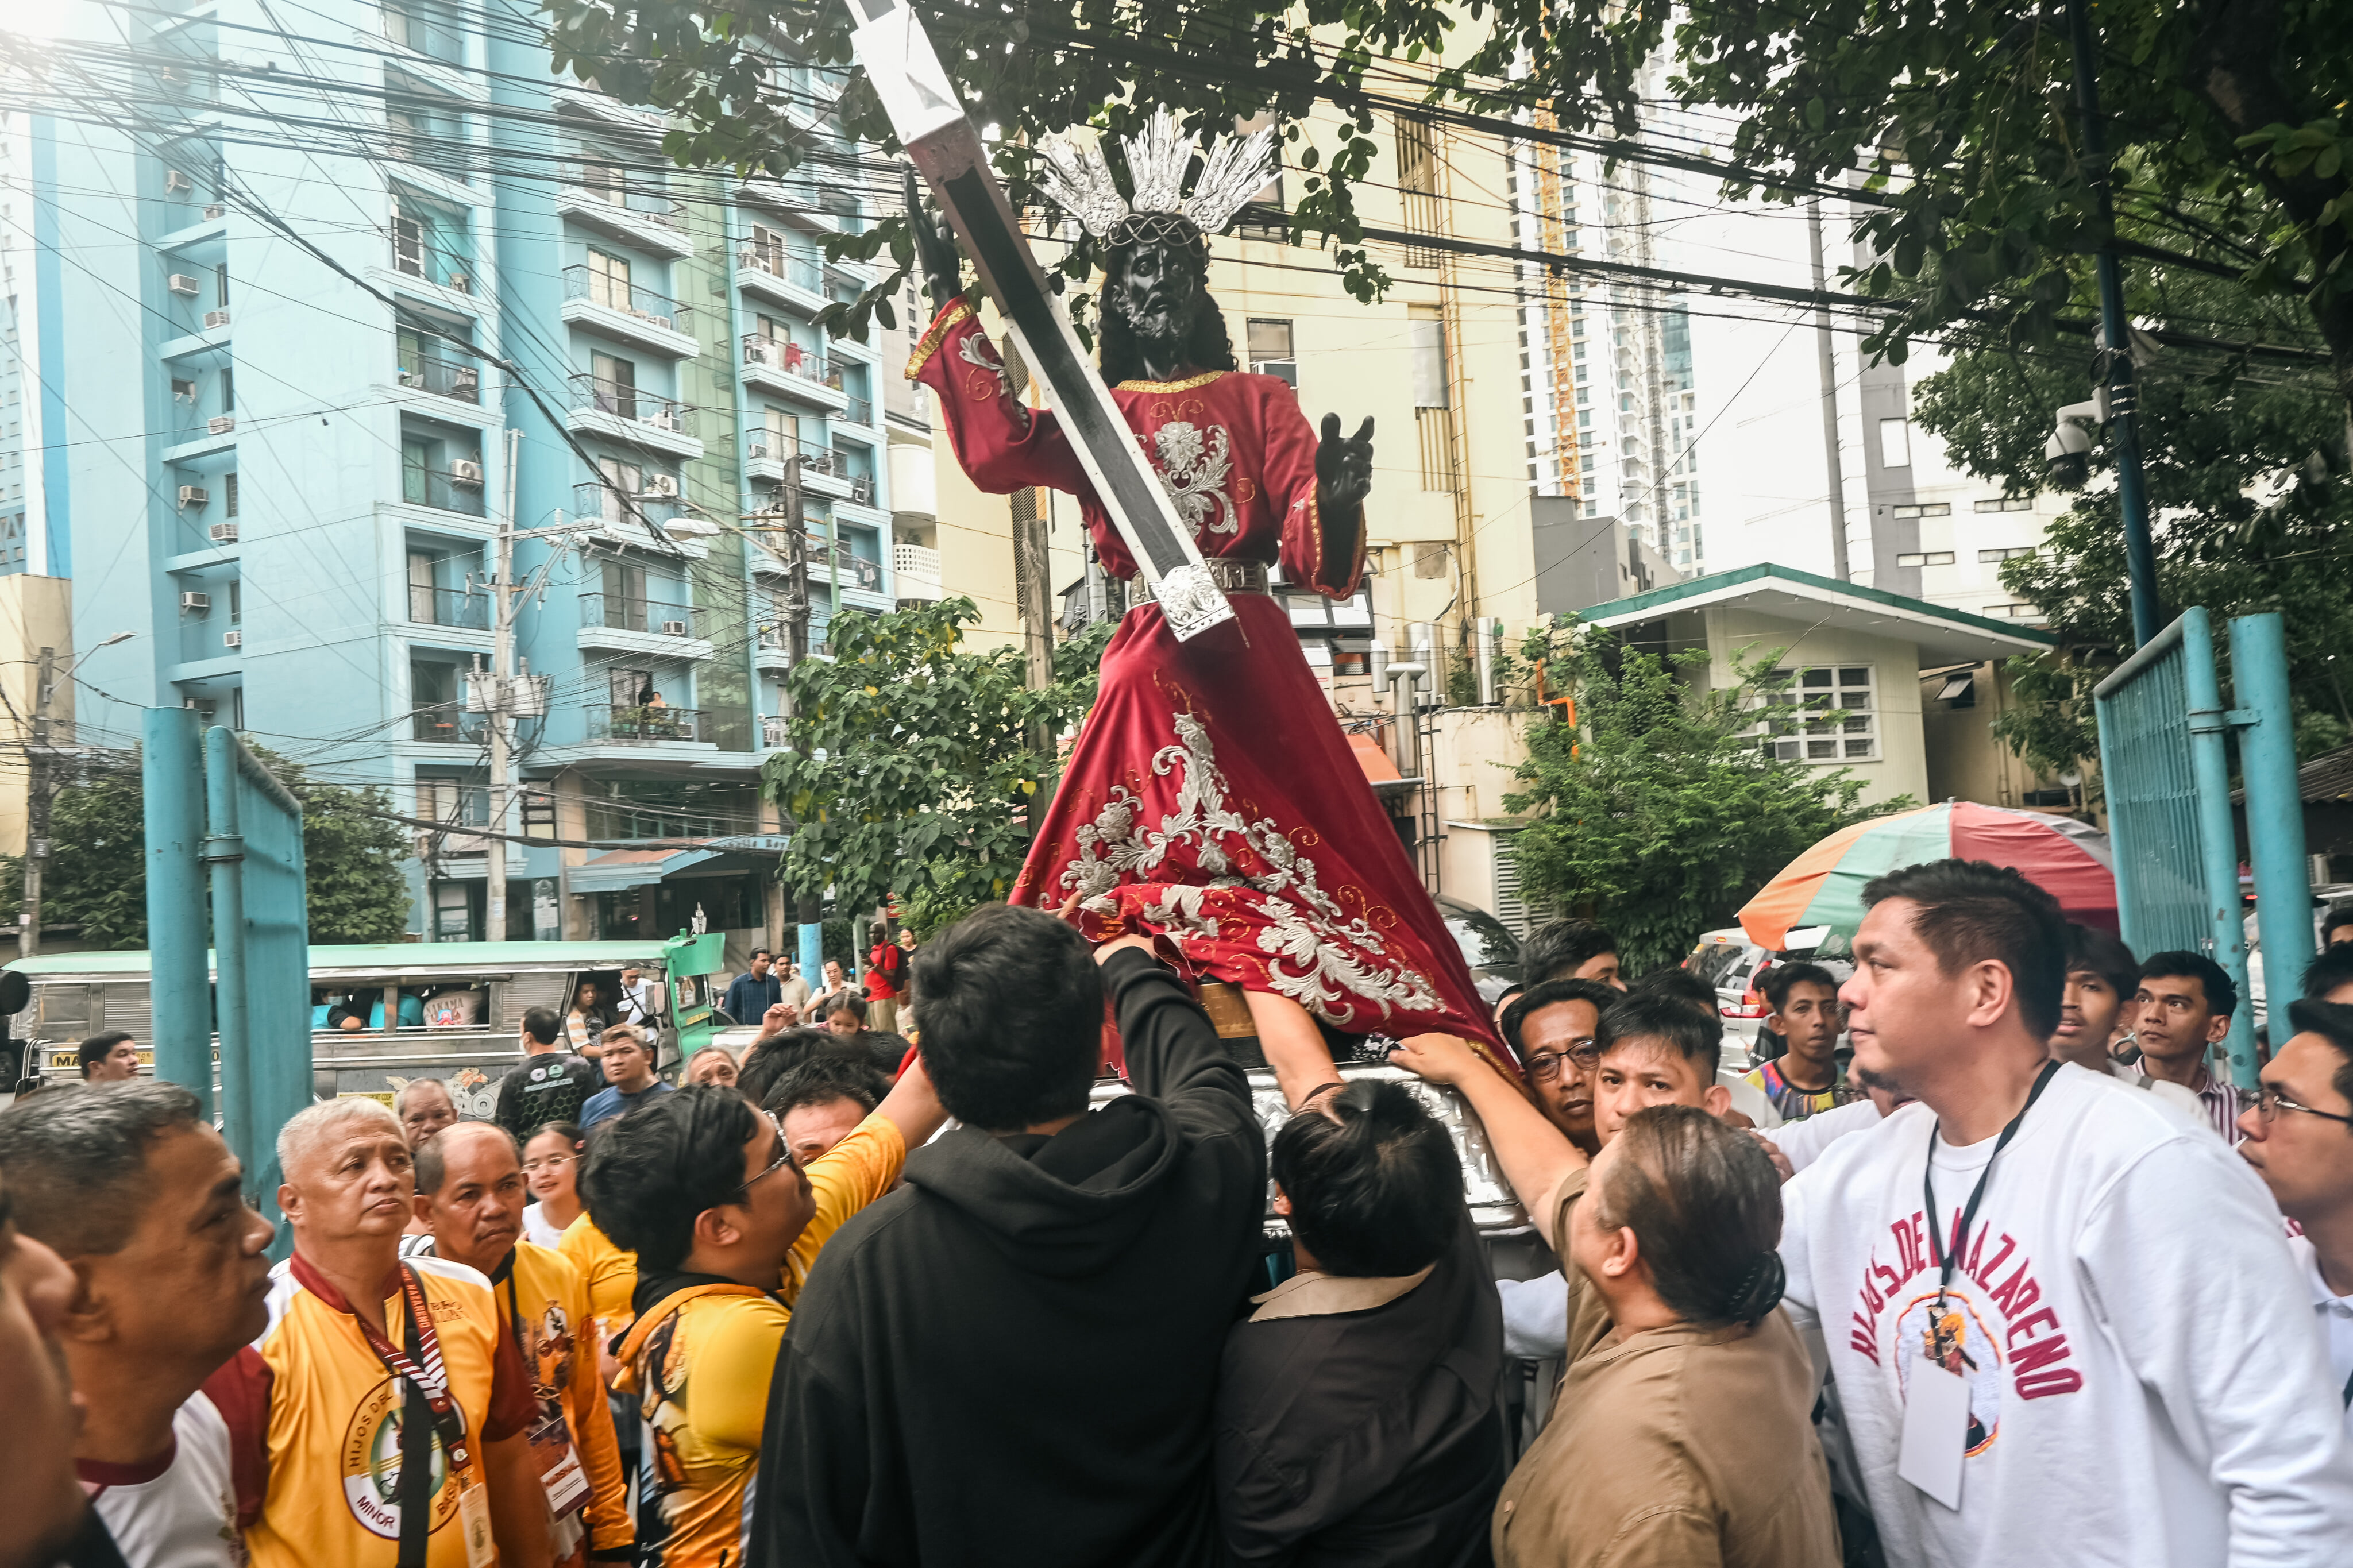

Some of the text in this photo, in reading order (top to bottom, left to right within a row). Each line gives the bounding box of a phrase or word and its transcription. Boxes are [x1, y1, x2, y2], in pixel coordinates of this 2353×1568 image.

[426, 998, 464, 1014] NAKAMA
[406, 1284, 431, 1328] NAZARENO
[1851, 1244, 1901, 1366] HIJOS
[1949, 1206, 2085, 1401] NAZARENO
[349, 1393, 393, 1467] HIJOS DEL
[357, 1495, 396, 1529] MINOR
